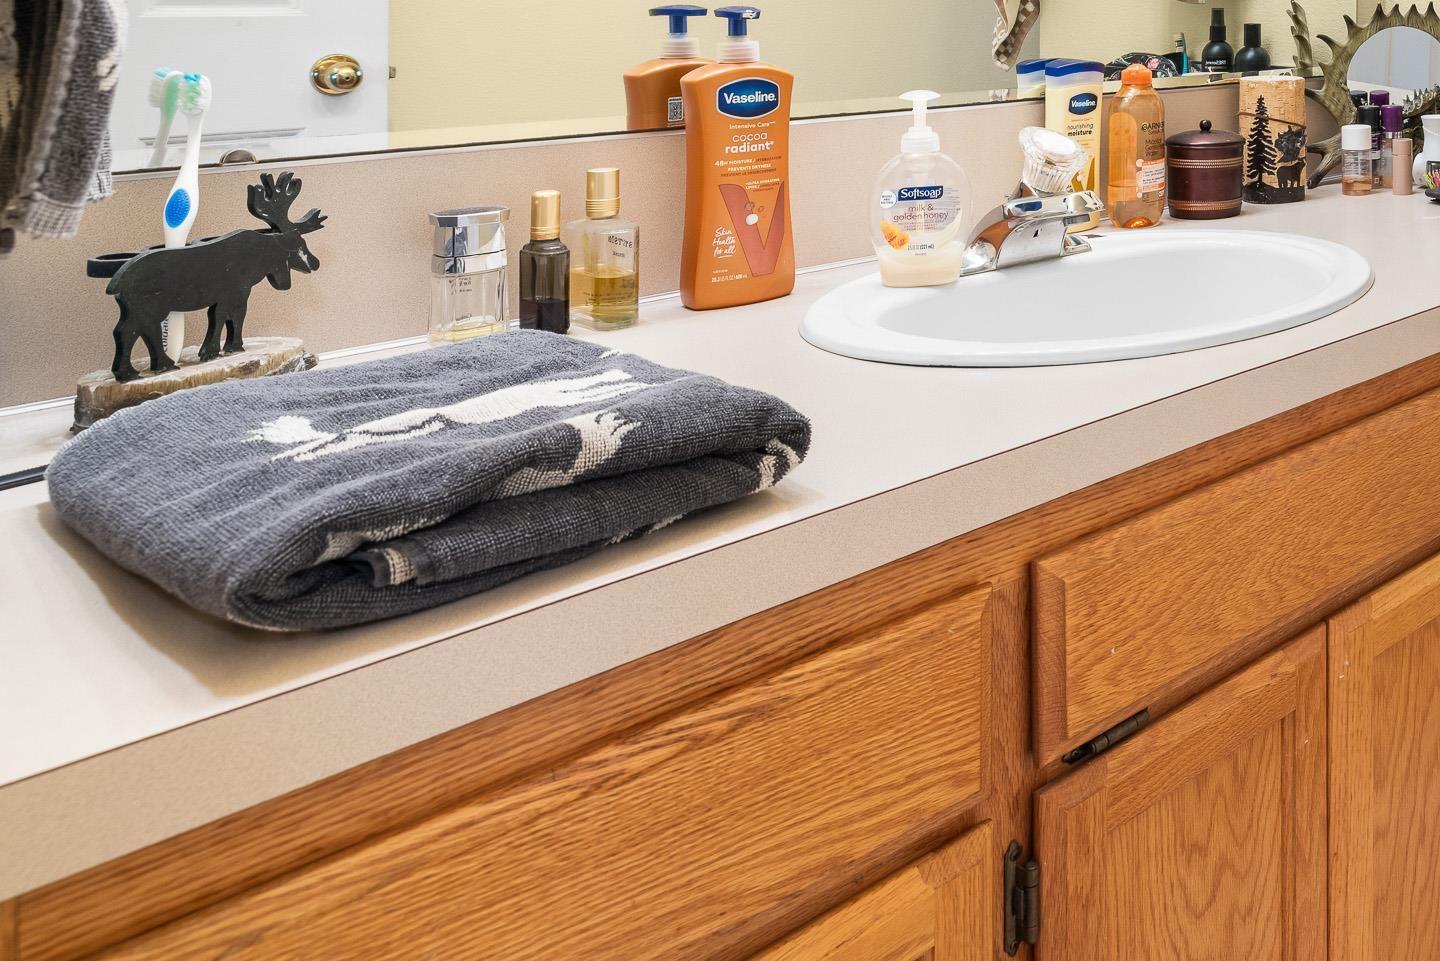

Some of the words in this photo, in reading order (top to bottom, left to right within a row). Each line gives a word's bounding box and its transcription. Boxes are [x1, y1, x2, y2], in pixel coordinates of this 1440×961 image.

[732, 132, 768, 143] cocoa
[900, 188, 941, 200] Softsoap
[908, 204, 926, 213] milk
[927, 203, 934, 212] &
[893, 212, 922, 223] golden
[923, 211, 949, 221] honey
